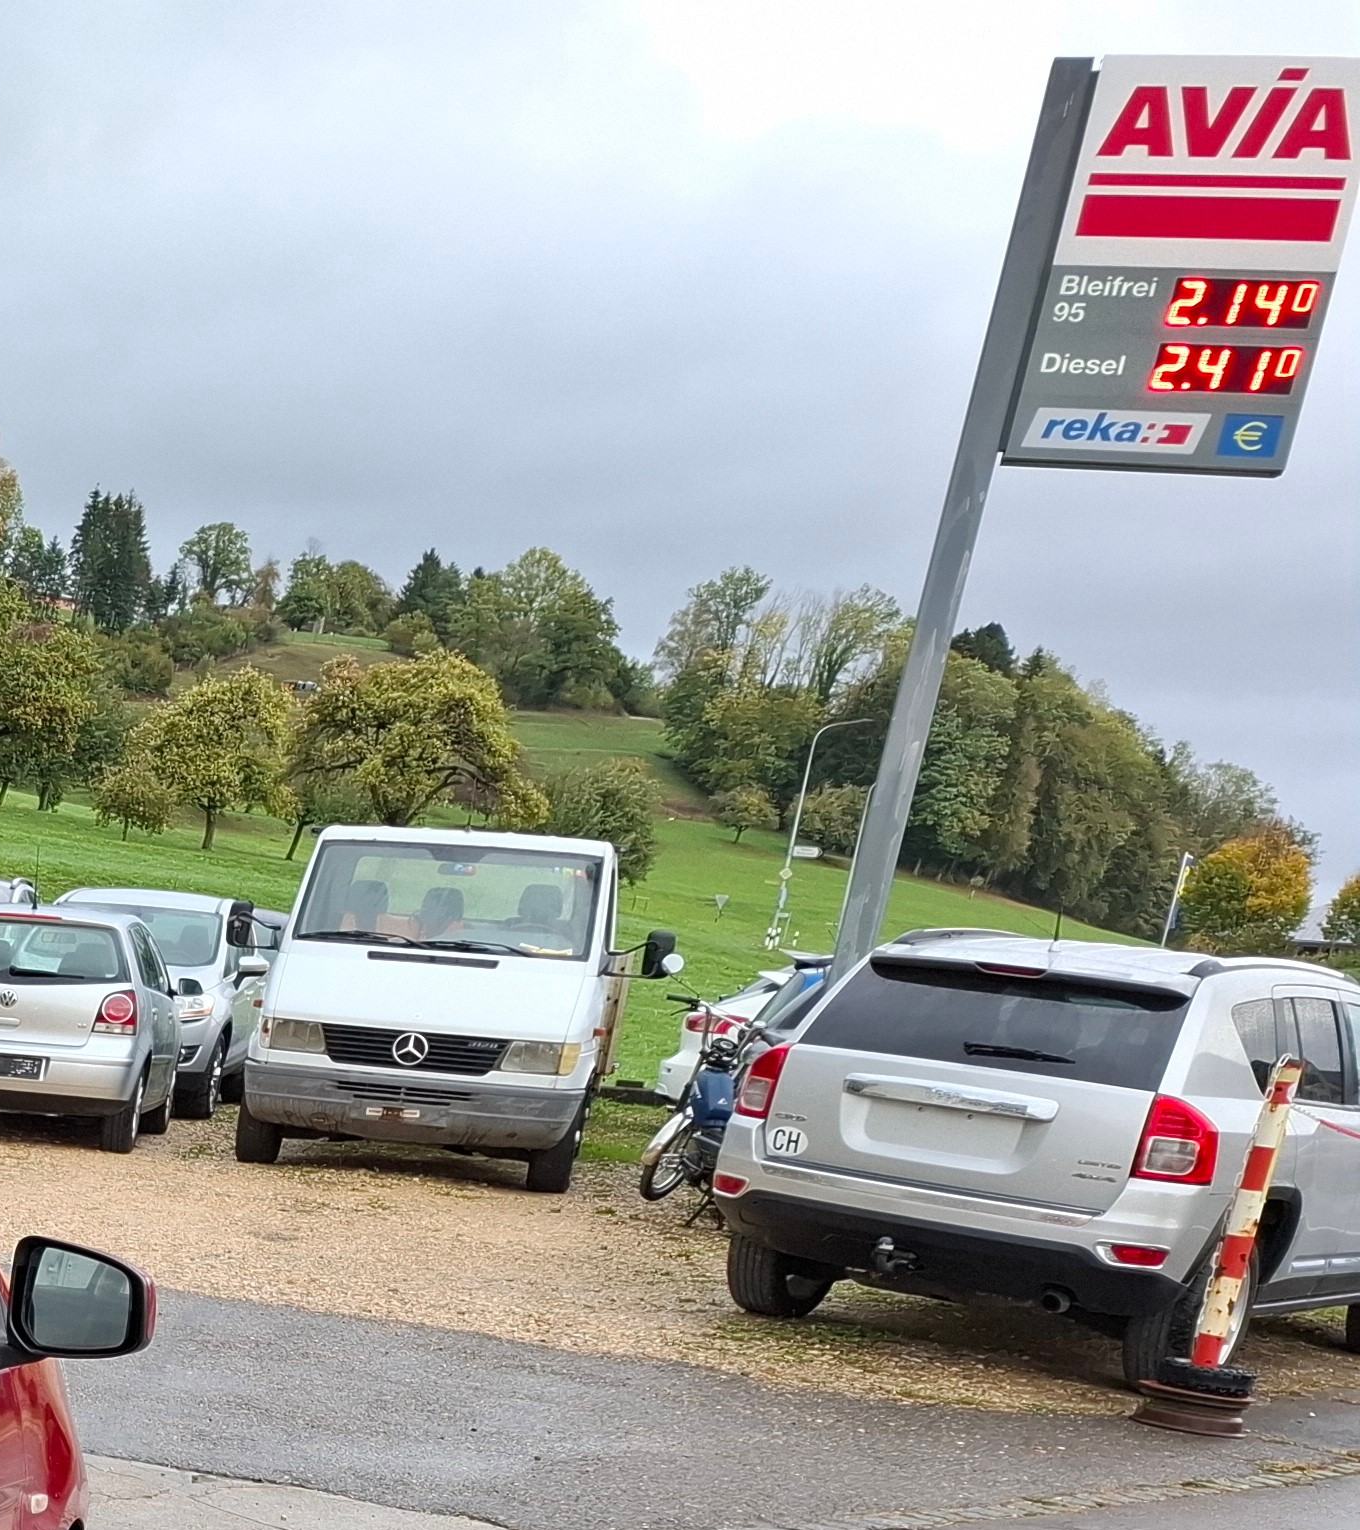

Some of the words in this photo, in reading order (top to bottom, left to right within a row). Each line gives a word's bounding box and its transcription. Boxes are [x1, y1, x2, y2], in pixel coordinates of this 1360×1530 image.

[1096, 68, 1351, 160] AVIA
[1059, 275, 1159, 297] Bleifrei
[1052, 302, 1086, 322] 95
[1040, 353, 1127, 376] Diesel
[773, 1128, 801, 1153] CH
